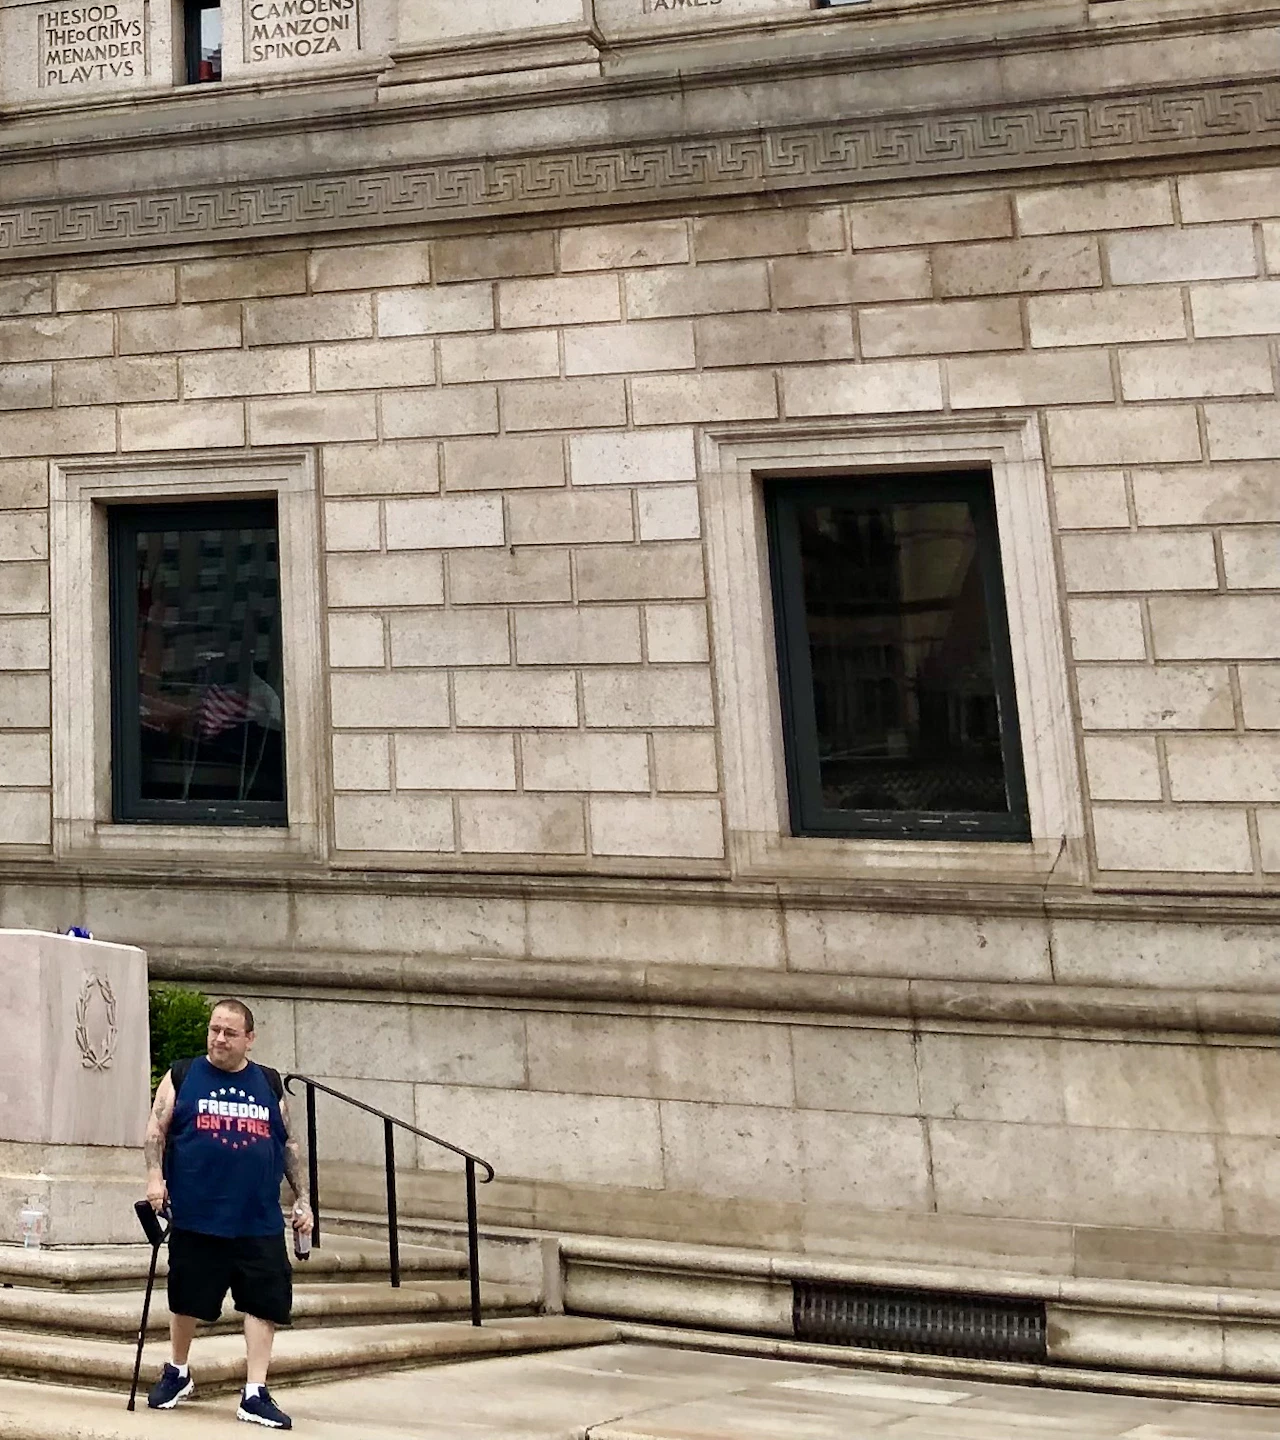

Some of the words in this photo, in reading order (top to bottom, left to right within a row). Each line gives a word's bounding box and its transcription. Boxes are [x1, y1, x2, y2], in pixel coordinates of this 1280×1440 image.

[47, 5, 118, 28] HESIOD
[251, 14, 349, 41] MANZONI
[46, 20, 141, 47] THEOCRITVS
[46, 40, 142, 66] MENANDER
[252, 36, 341, 62] SPINOZA
[47, 61, 134, 87] PLAVTVS
[199, 1099, 269, 1121] FREEDOM
[197, 1115, 233, 1130] ISN'T
[237, 1118, 270, 1137] FREE
